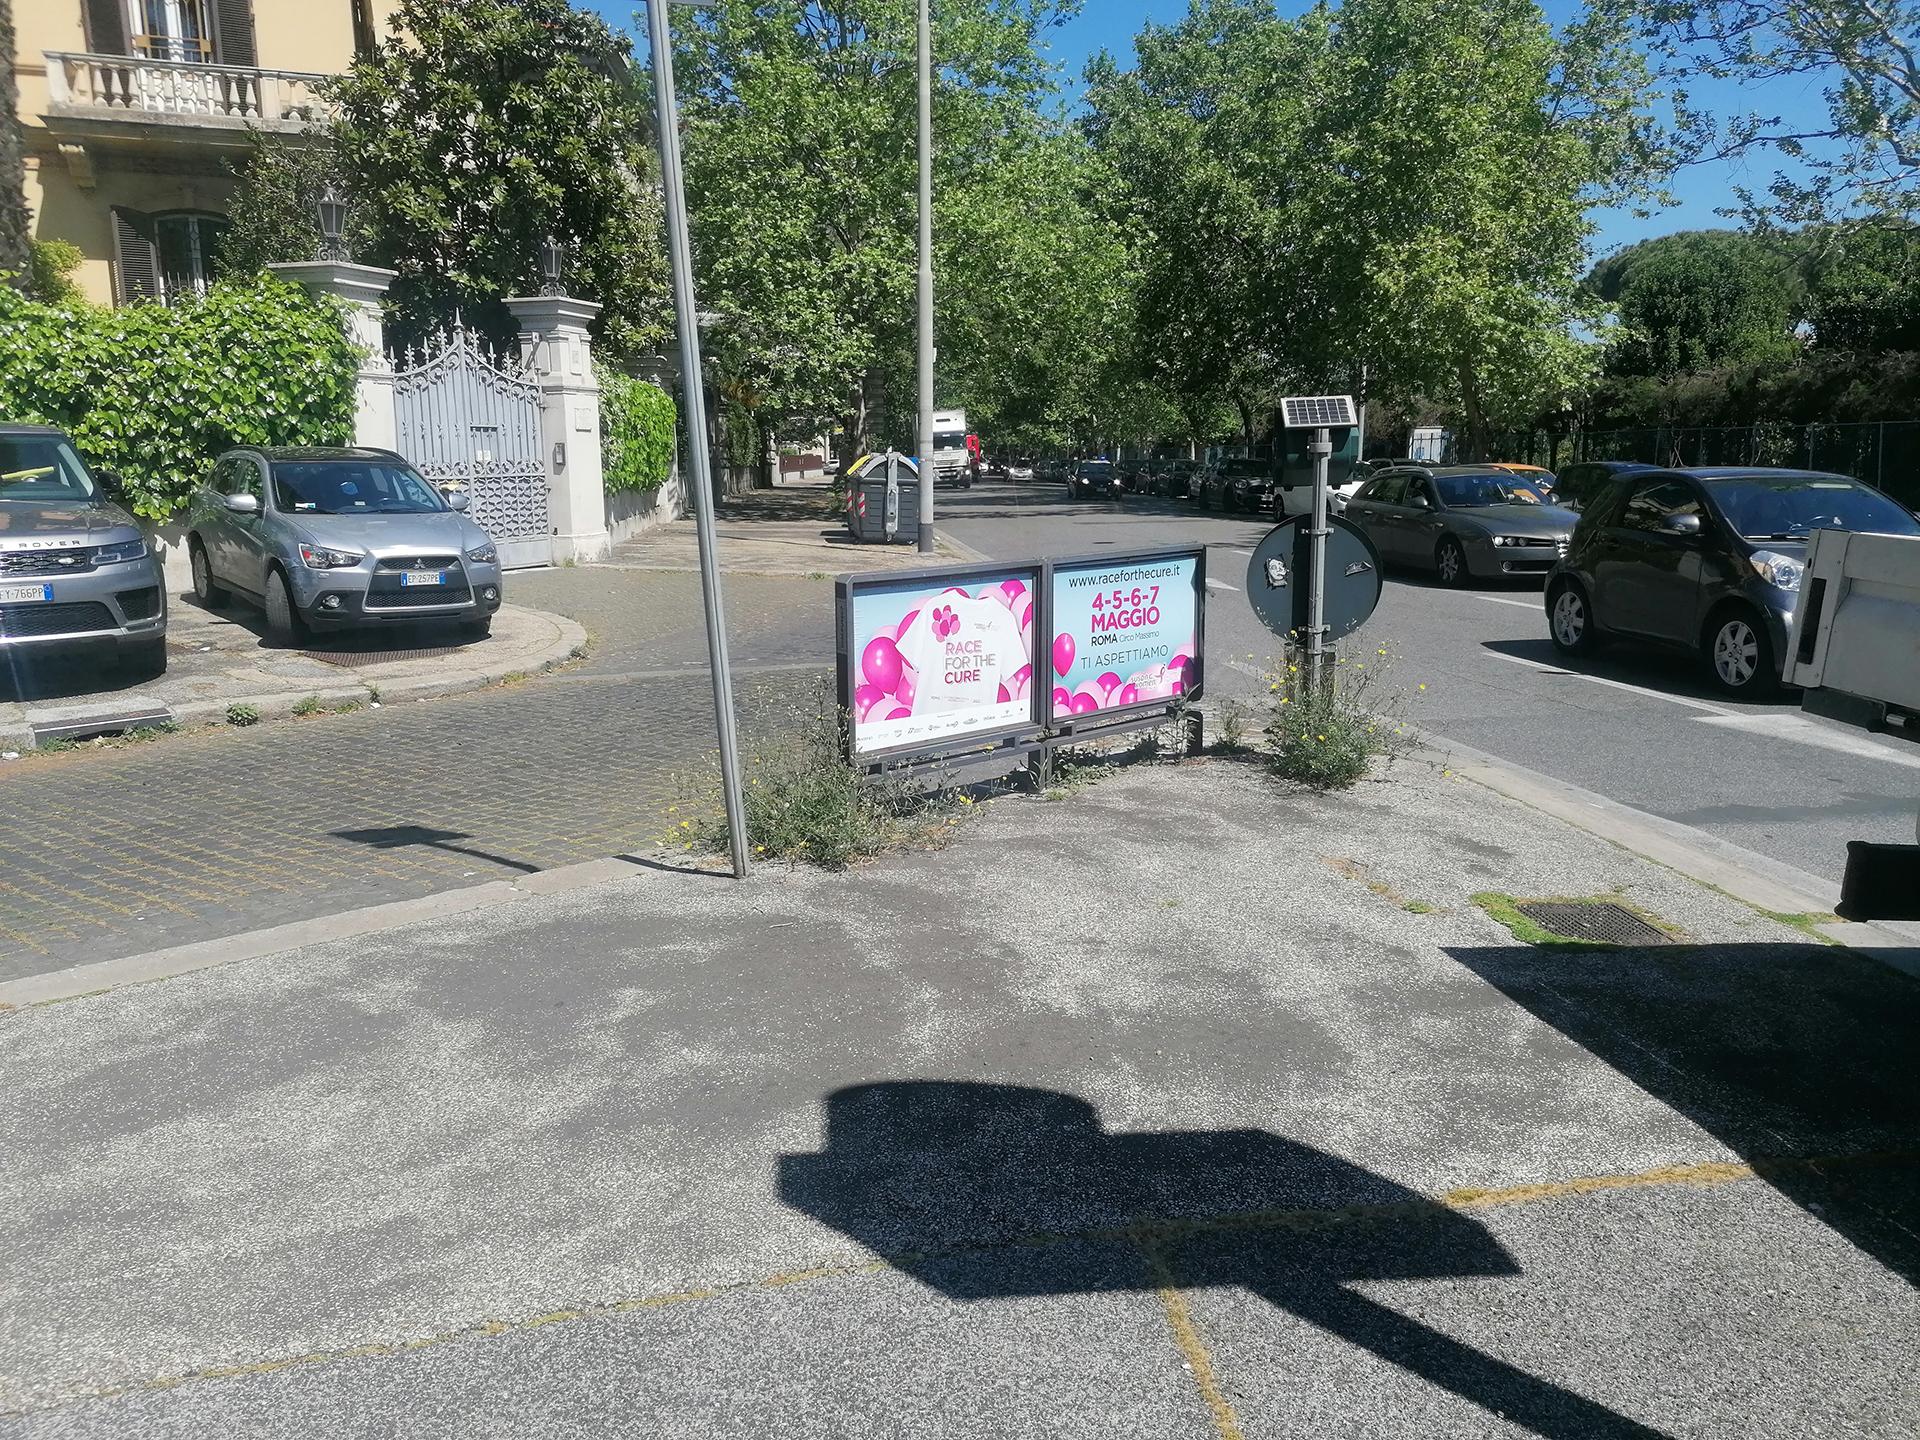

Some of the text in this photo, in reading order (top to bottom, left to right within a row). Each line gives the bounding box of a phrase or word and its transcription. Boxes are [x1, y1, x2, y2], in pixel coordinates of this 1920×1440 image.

[19, 540, 81, 548] ROVER
[1068, 564, 1180, 588] www.raceforthecure.it
[1091, 586, 1160, 611] 4-5-6-7
[1091, 606, 1160, 633] MAGGIO
[1091, 630, 1160, 647] ROMA Circo Massimo
[945, 640, 982, 656] RACE
[1081, 644, 1169, 669] TI ASPETTIAMO
[945, 653, 996, 670] FOR THE
[945, 669, 981, 685] CURE
